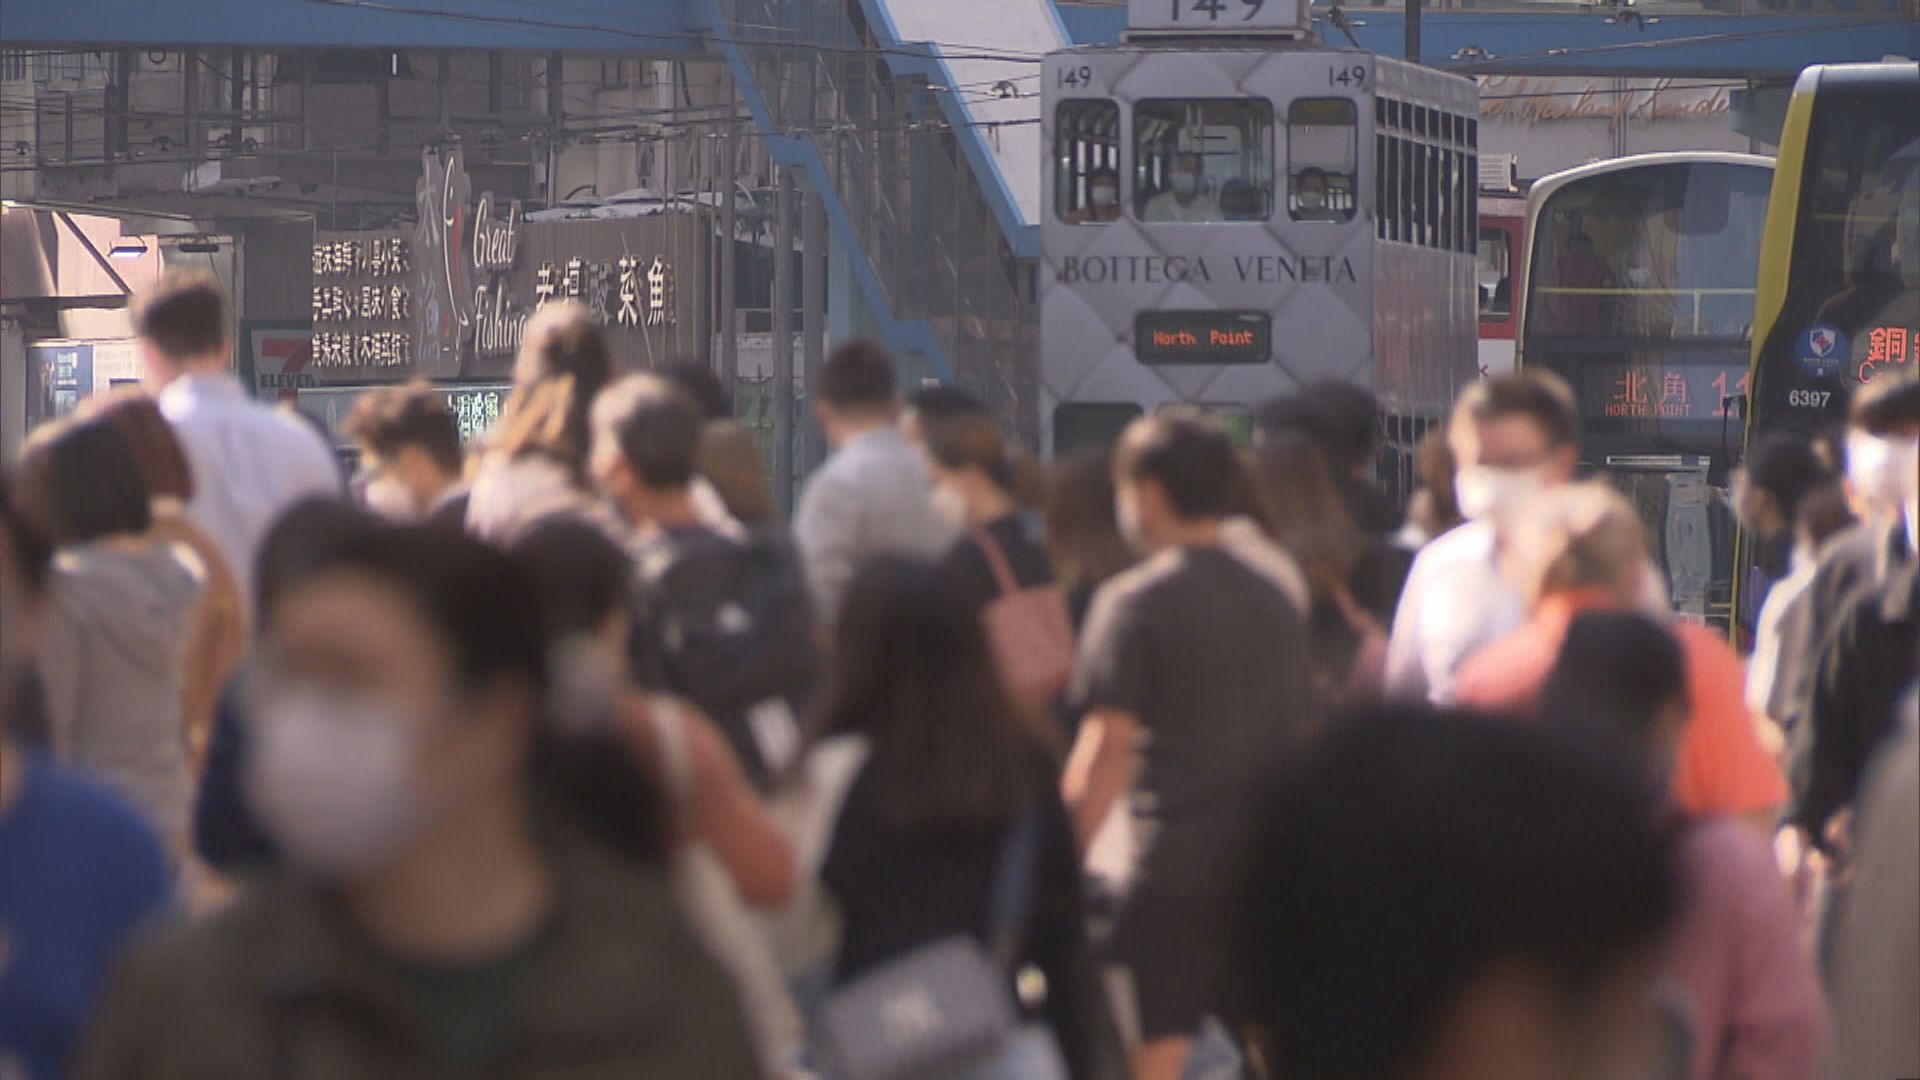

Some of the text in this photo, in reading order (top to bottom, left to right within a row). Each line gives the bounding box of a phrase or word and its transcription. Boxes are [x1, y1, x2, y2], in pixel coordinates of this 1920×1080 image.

[1057, 65, 1091, 88] 149
[1329, 65, 1366, 88] 149
[473, 198, 515, 269] Great
[1063, 255, 1357, 284] BOTTEGA VENETA
[1153, 328, 1254, 346] North Point
[1867, 326, 1919, 364] 銅
[262, 339, 313, 398] 7
[1613, 369, 1687, 404] 北角
[1788, 389, 1831, 408] 6397
[1605, 402, 1693, 418] NORTH POINT
